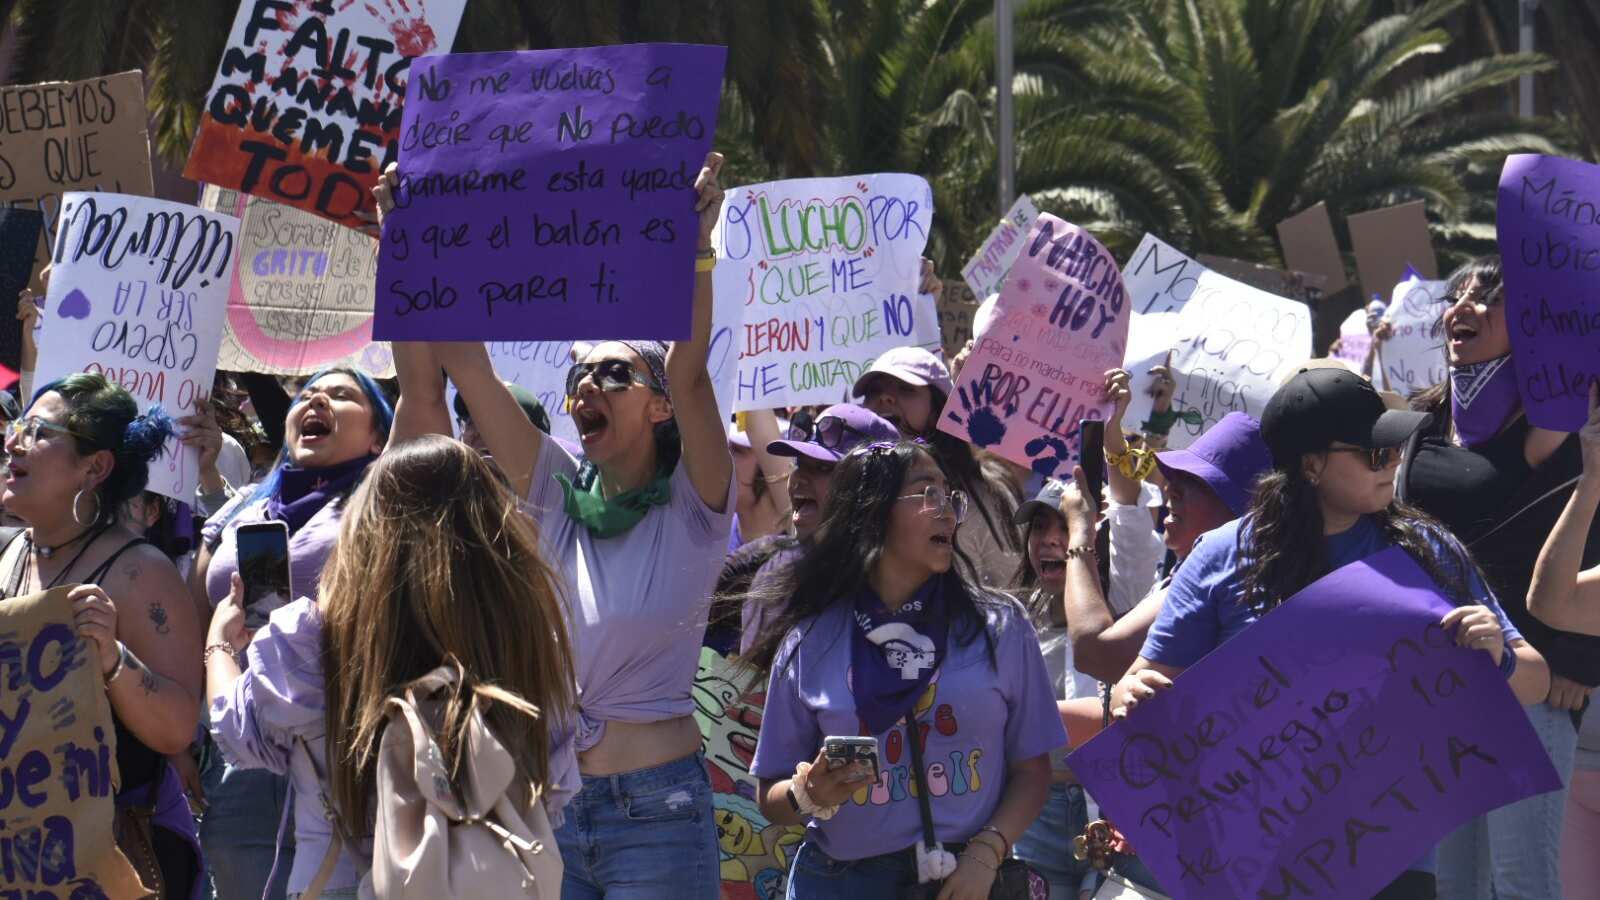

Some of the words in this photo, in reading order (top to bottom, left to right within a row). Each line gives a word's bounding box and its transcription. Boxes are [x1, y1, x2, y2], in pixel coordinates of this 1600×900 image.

[418, 64, 450, 102] No
[470, 71, 511, 96] me
[646, 65, 673, 89] a
[488, 121, 533, 153] que
[558, 105, 594, 142] No
[45, 131, 101, 185] QUE
[239, 140, 366, 219] TOD
[547, 160, 605, 192] esta
[389, 223, 410, 261] y
[422, 221, 472, 258] que
[486, 214, 512, 249] el
[640, 215, 676, 243] es
[757, 195, 866, 256] LUCHO
[868, 195, 926, 246] POR
[760, 262, 829, 304] QUE
[831, 256, 873, 294] ME
[1029, 221, 1124, 315] MARCHO
[113, 280, 148, 317] LA
[157, 289, 198, 331] SER
[1049, 284, 1115, 339] HOY
[740, 315, 810, 359] IERON
[830, 309, 882, 347] QUE
[883, 294, 914, 337] NO
[738, 363, 786, 401] HE
[979, 363, 1031, 419] POR
[1252, 655, 1293, 709] el
[59, 726, 111, 802] mi
[1178, 849, 1231, 887] te
[1411, 666, 1470, 707] la
